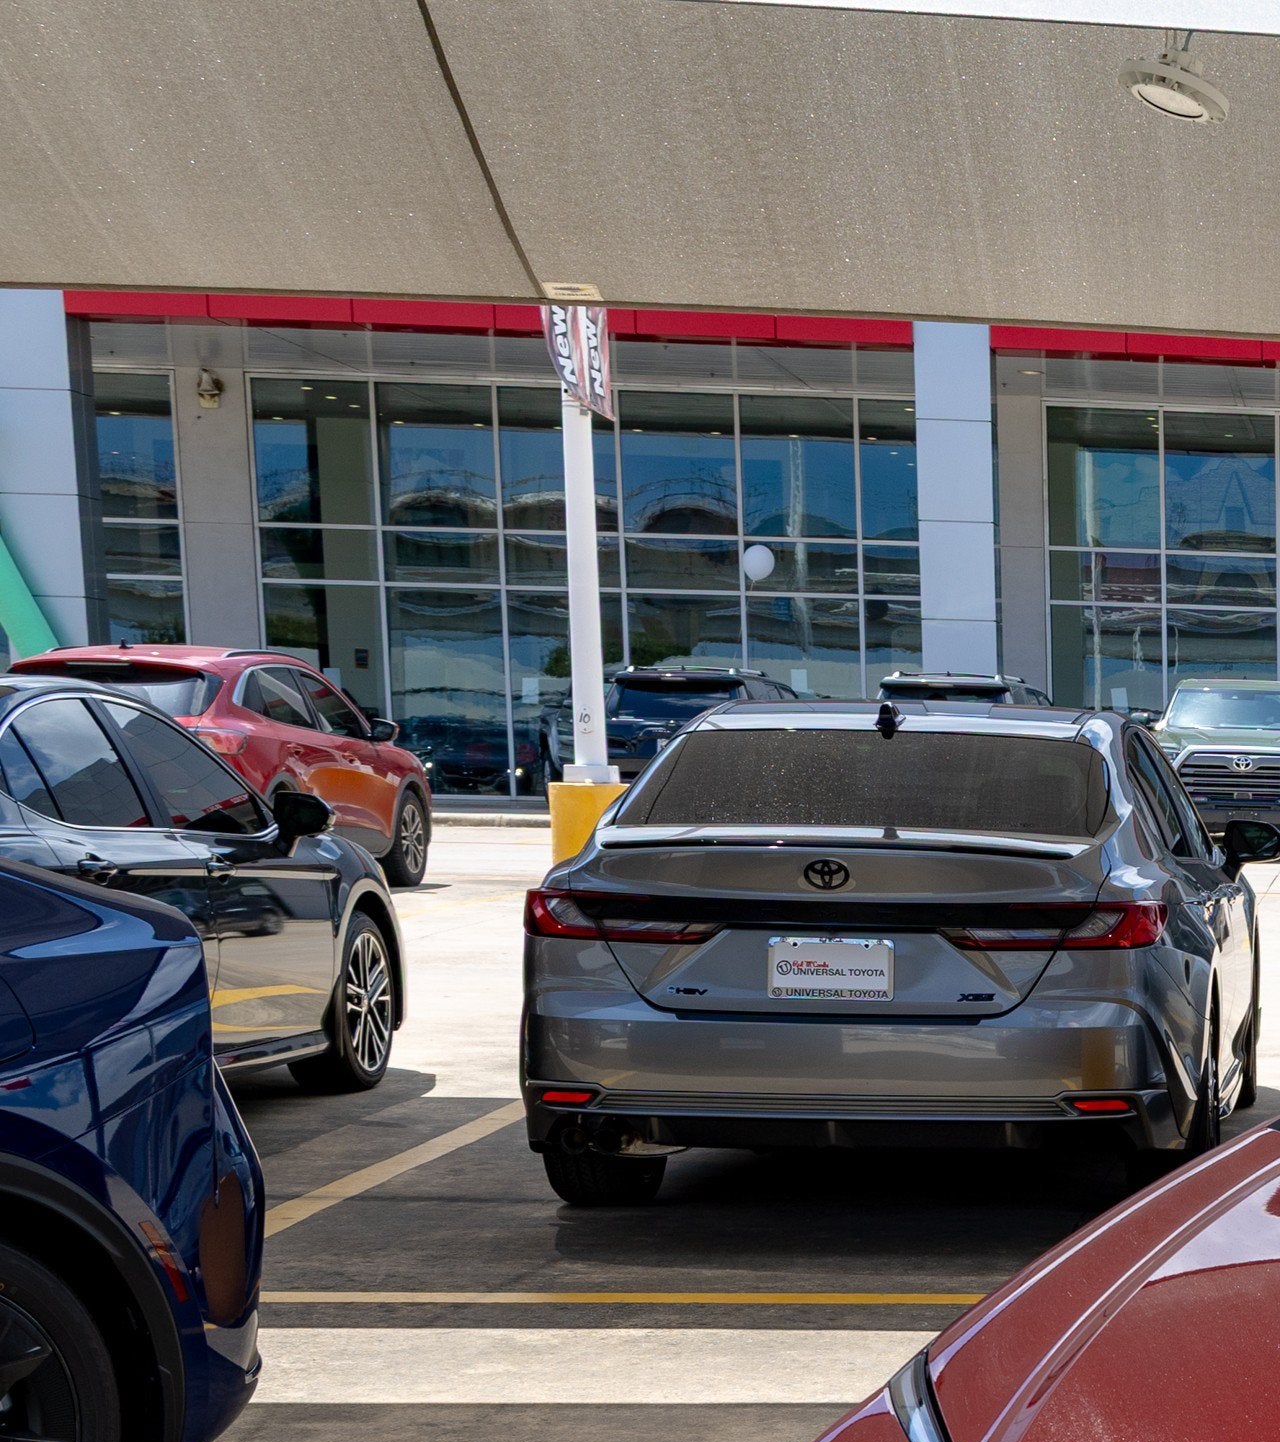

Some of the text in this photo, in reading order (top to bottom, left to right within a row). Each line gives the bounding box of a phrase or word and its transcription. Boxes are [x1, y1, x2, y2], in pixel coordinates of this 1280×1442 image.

[579, 712, 591, 724] 10
[792, 968, 885, 977] UNIVERSAL TOYOTA
[786, 988, 848, 998] UNIVERSAL
[849, 989, 889, 999] TOYOTA
